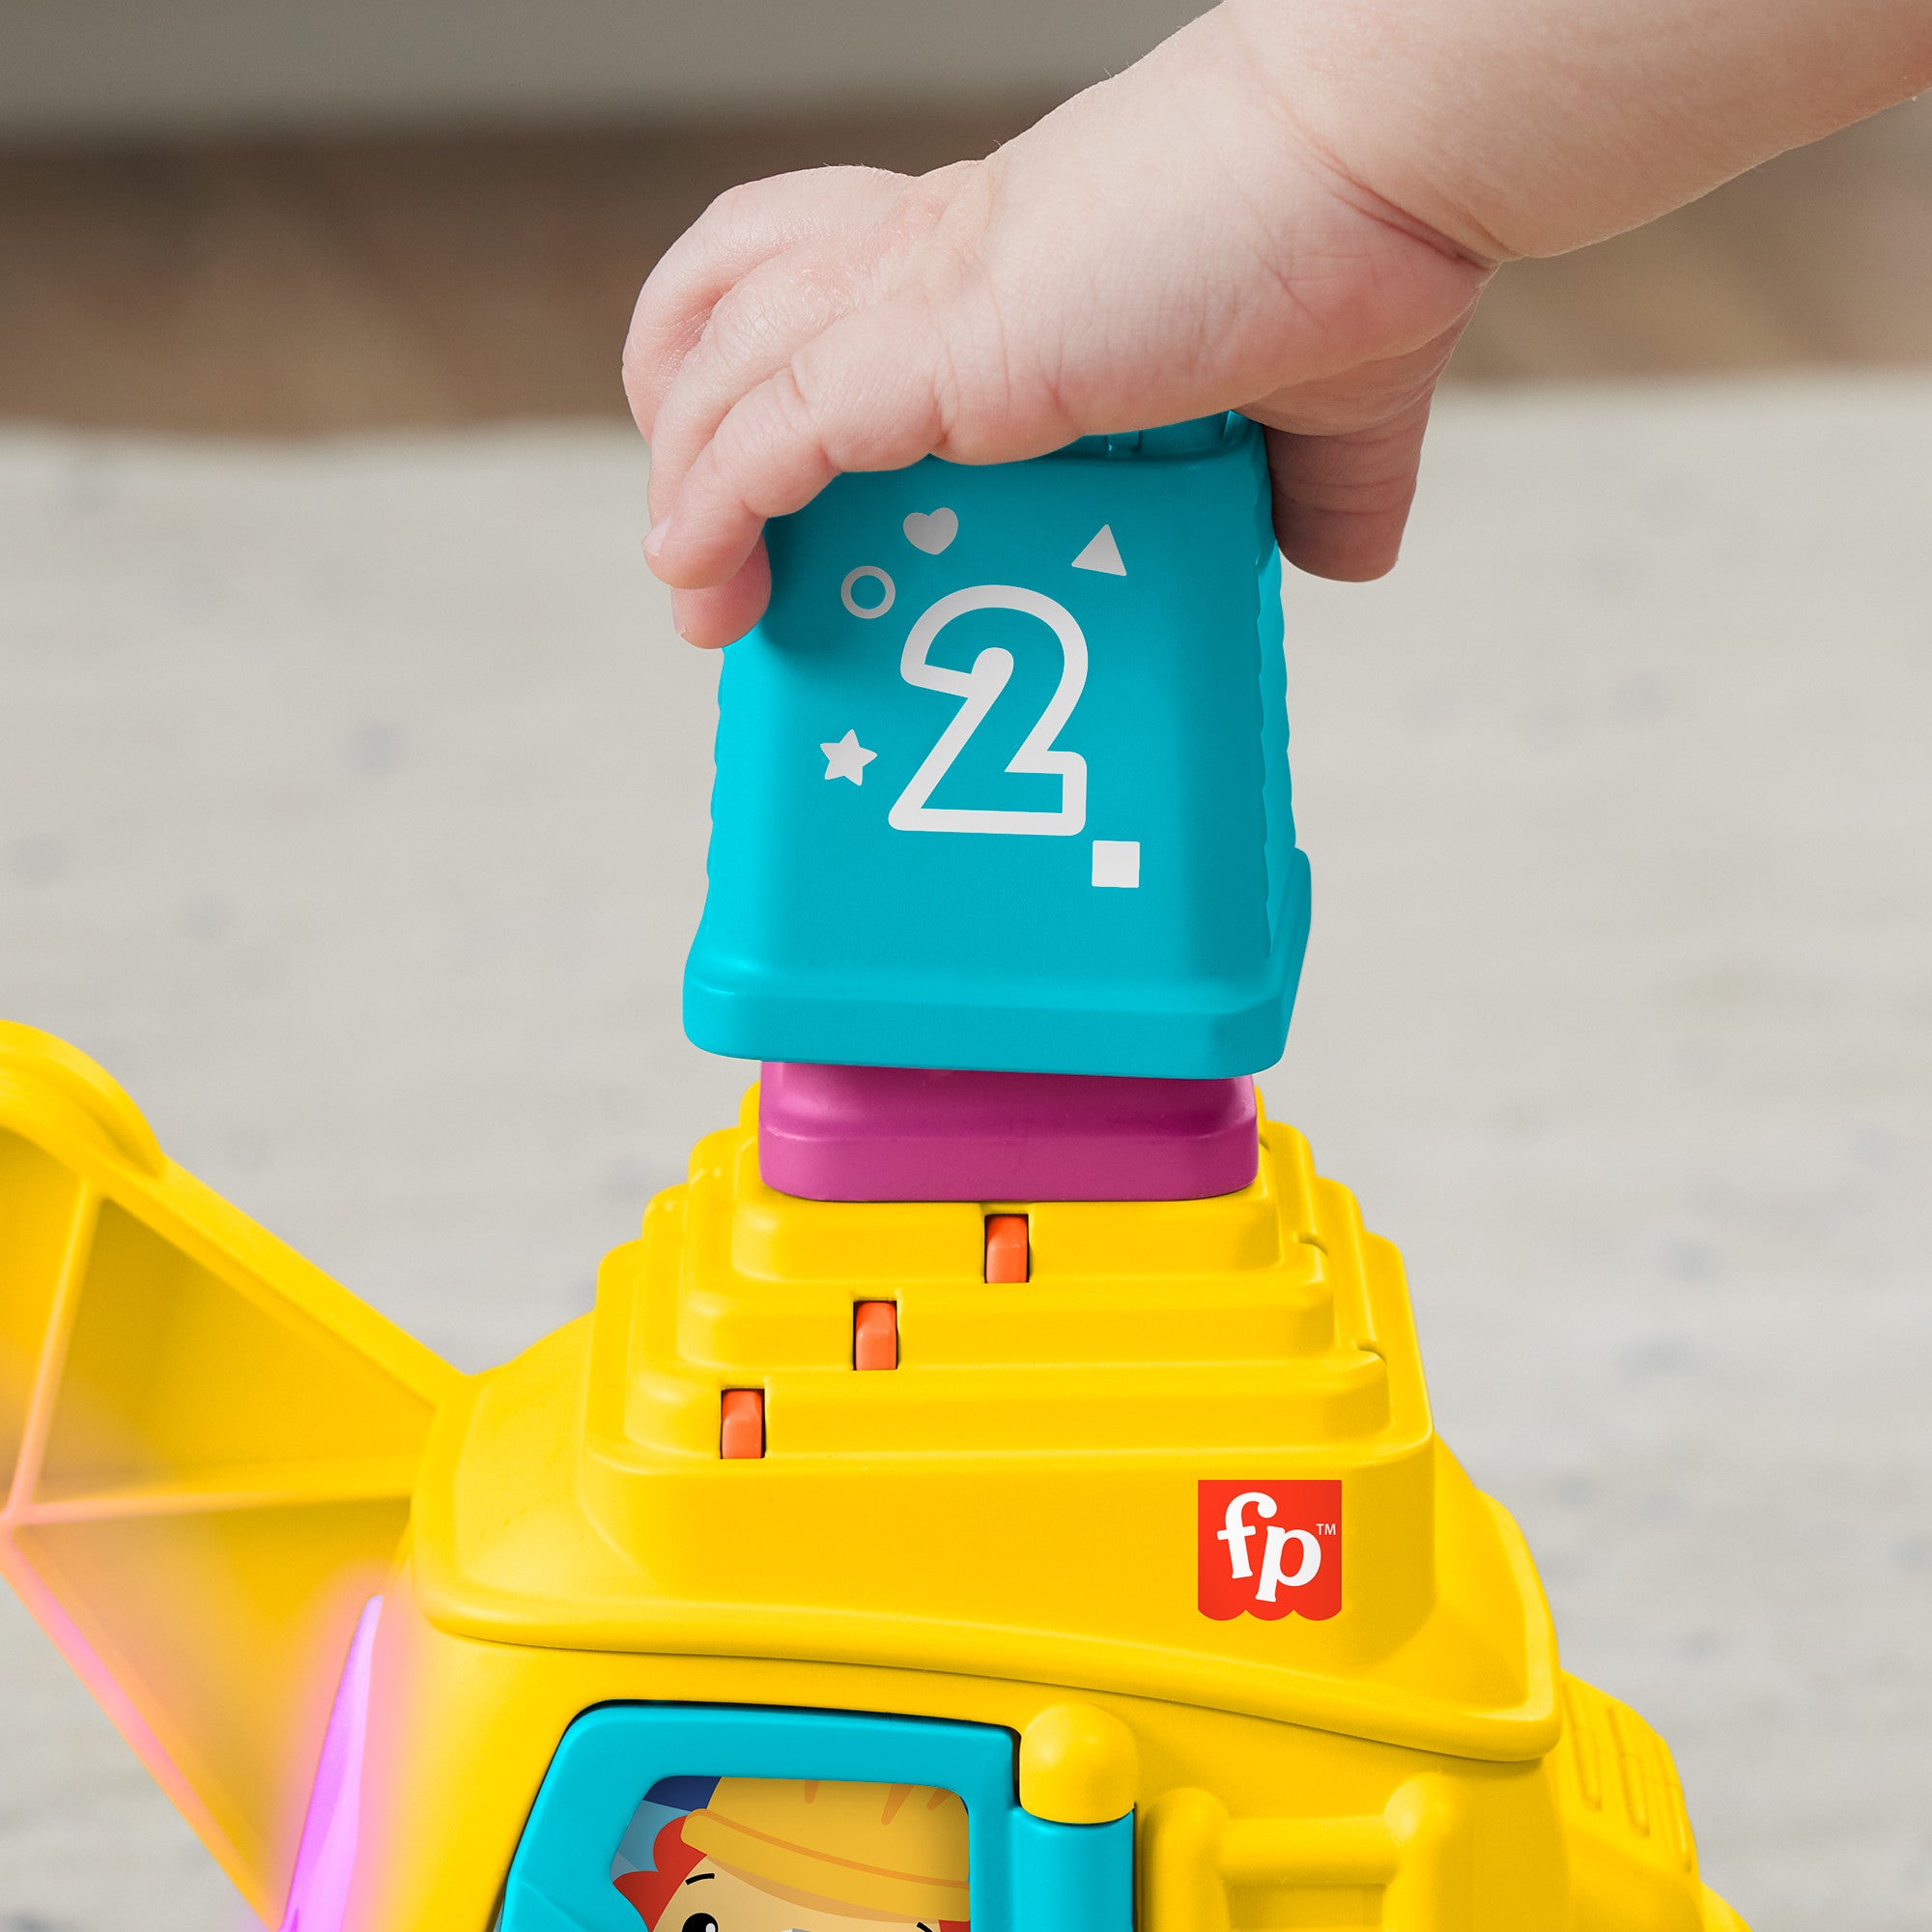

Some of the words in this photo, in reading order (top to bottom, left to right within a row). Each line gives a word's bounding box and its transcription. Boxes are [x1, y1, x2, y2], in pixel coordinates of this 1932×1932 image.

[888, 584, 1089, 837] 2
[1216, 1492, 1322, 1603] fp
[1316, 1523, 1337, 1536] TM
